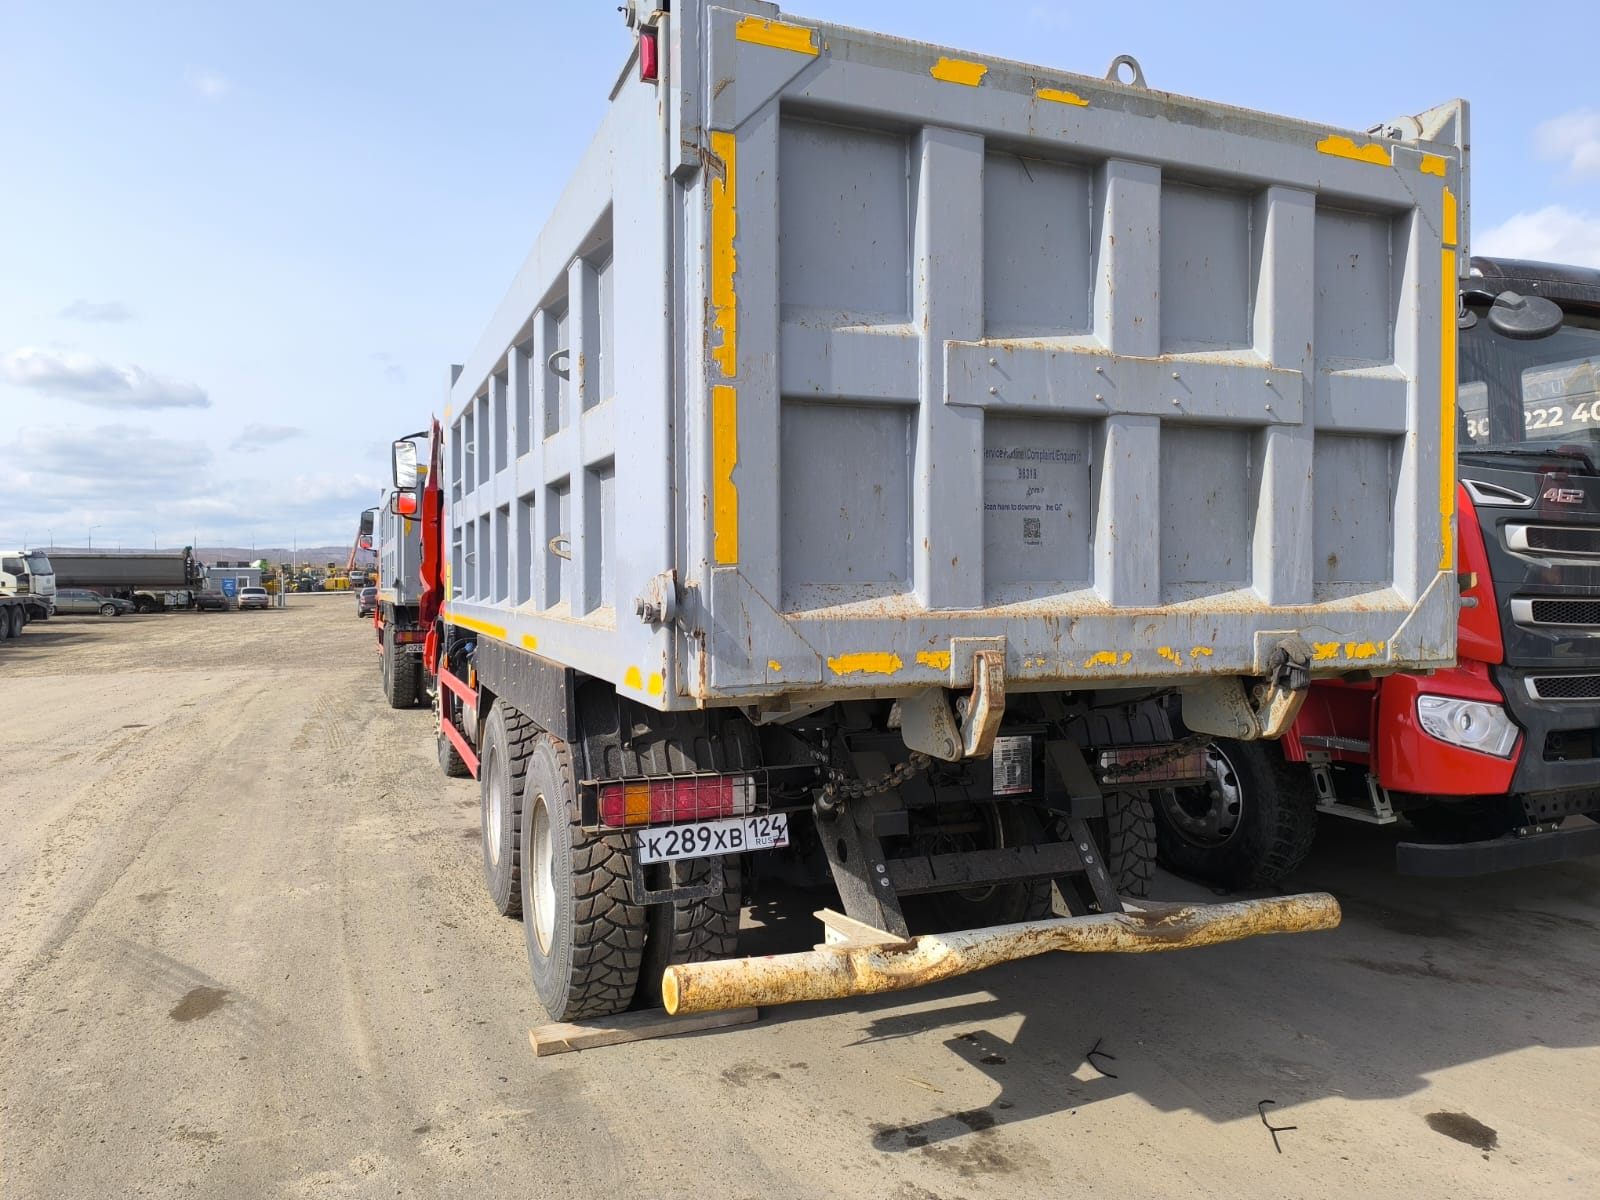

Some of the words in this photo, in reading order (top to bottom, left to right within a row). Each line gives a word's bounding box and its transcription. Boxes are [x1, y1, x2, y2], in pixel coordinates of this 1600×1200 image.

[649, 826, 744, 858] К289ХВ
[748, 815, 784, 839] 124
[755, 838, 774, 846] RUS
